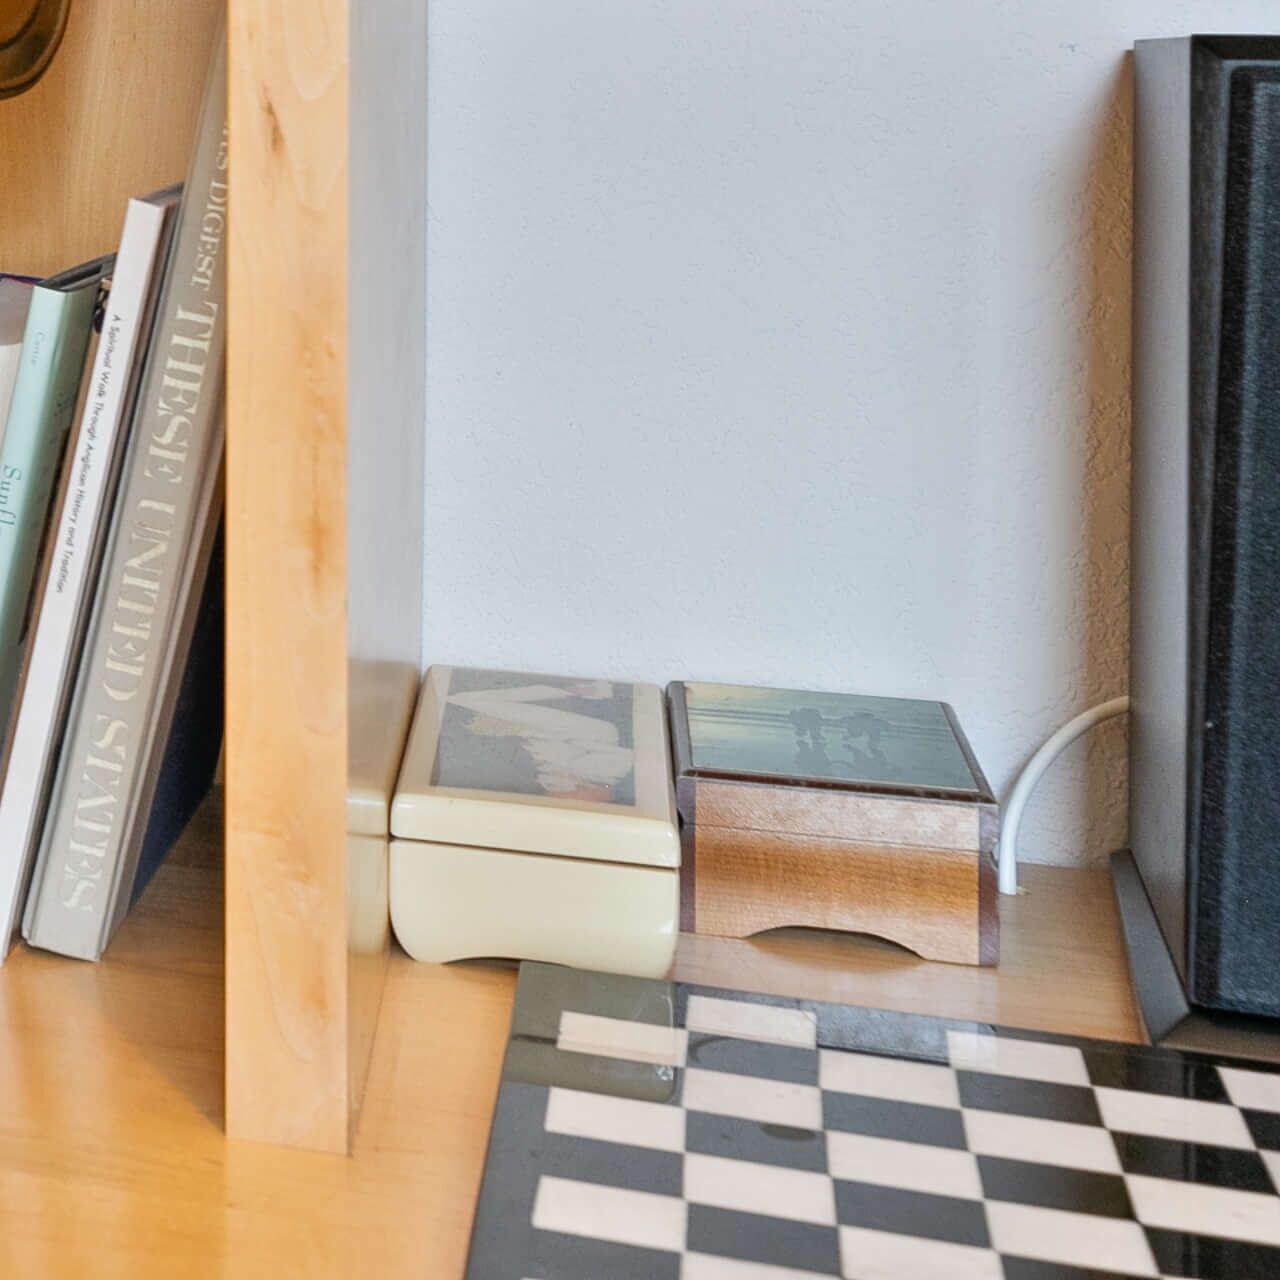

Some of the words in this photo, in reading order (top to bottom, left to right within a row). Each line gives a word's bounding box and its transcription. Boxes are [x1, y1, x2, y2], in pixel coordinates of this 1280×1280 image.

[188, 179, 228, 292] DIGEST
[112, 314, 122, 323] A
[103, 326, 120, 369] Spiritual
[97, 371, 110, 398] Walk
[142, 300, 219, 483] THESE
[87, 402, 105, 441] Through
[78, 444, 95, 487] Anglican
[69, 488, 86, 523] History
[65, 526, 76, 546] and
[56, 549, 74, 594] Tradition
[103, 498, 178, 699] UNITED
[61, 713, 130, 914] STATES
